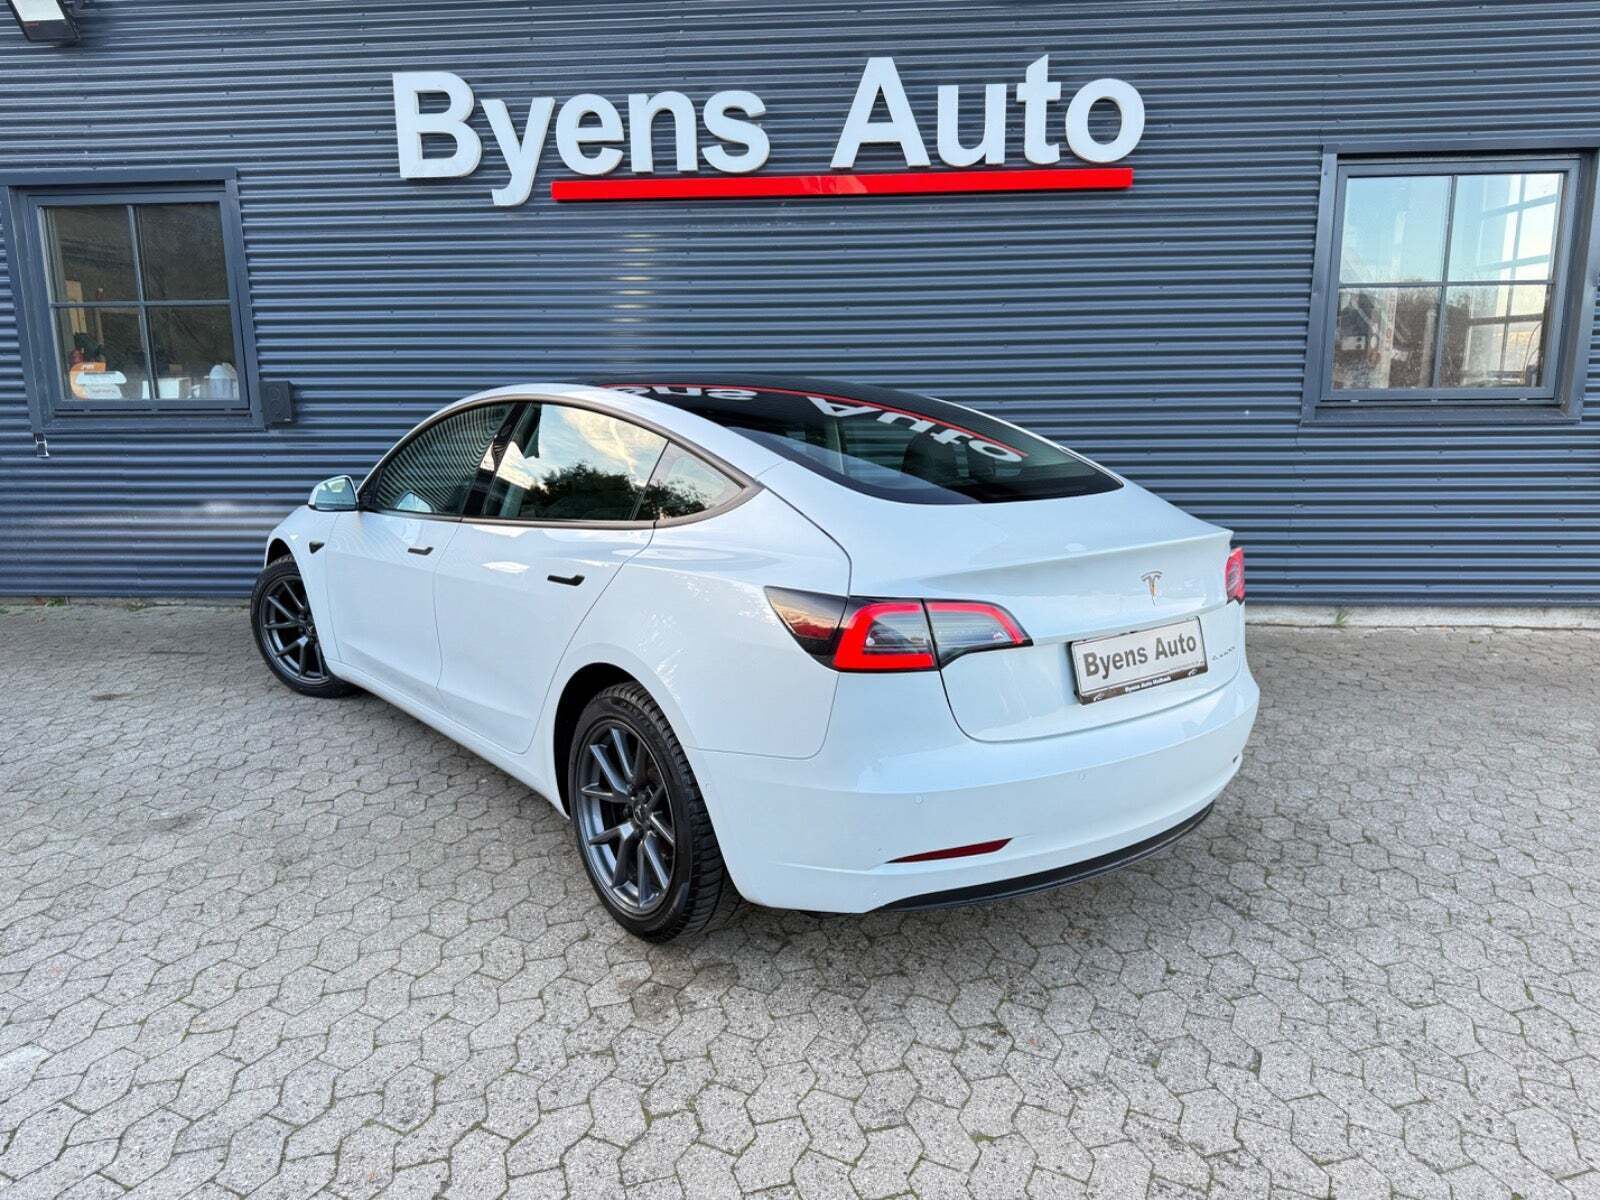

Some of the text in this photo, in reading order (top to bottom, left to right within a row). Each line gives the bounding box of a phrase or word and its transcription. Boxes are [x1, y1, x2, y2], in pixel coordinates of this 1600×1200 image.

[392, 54, 1147, 207] Byens Auto
[1083, 646, 1148, 679] Byens
[1155, 634, 1197, 660] Auto
